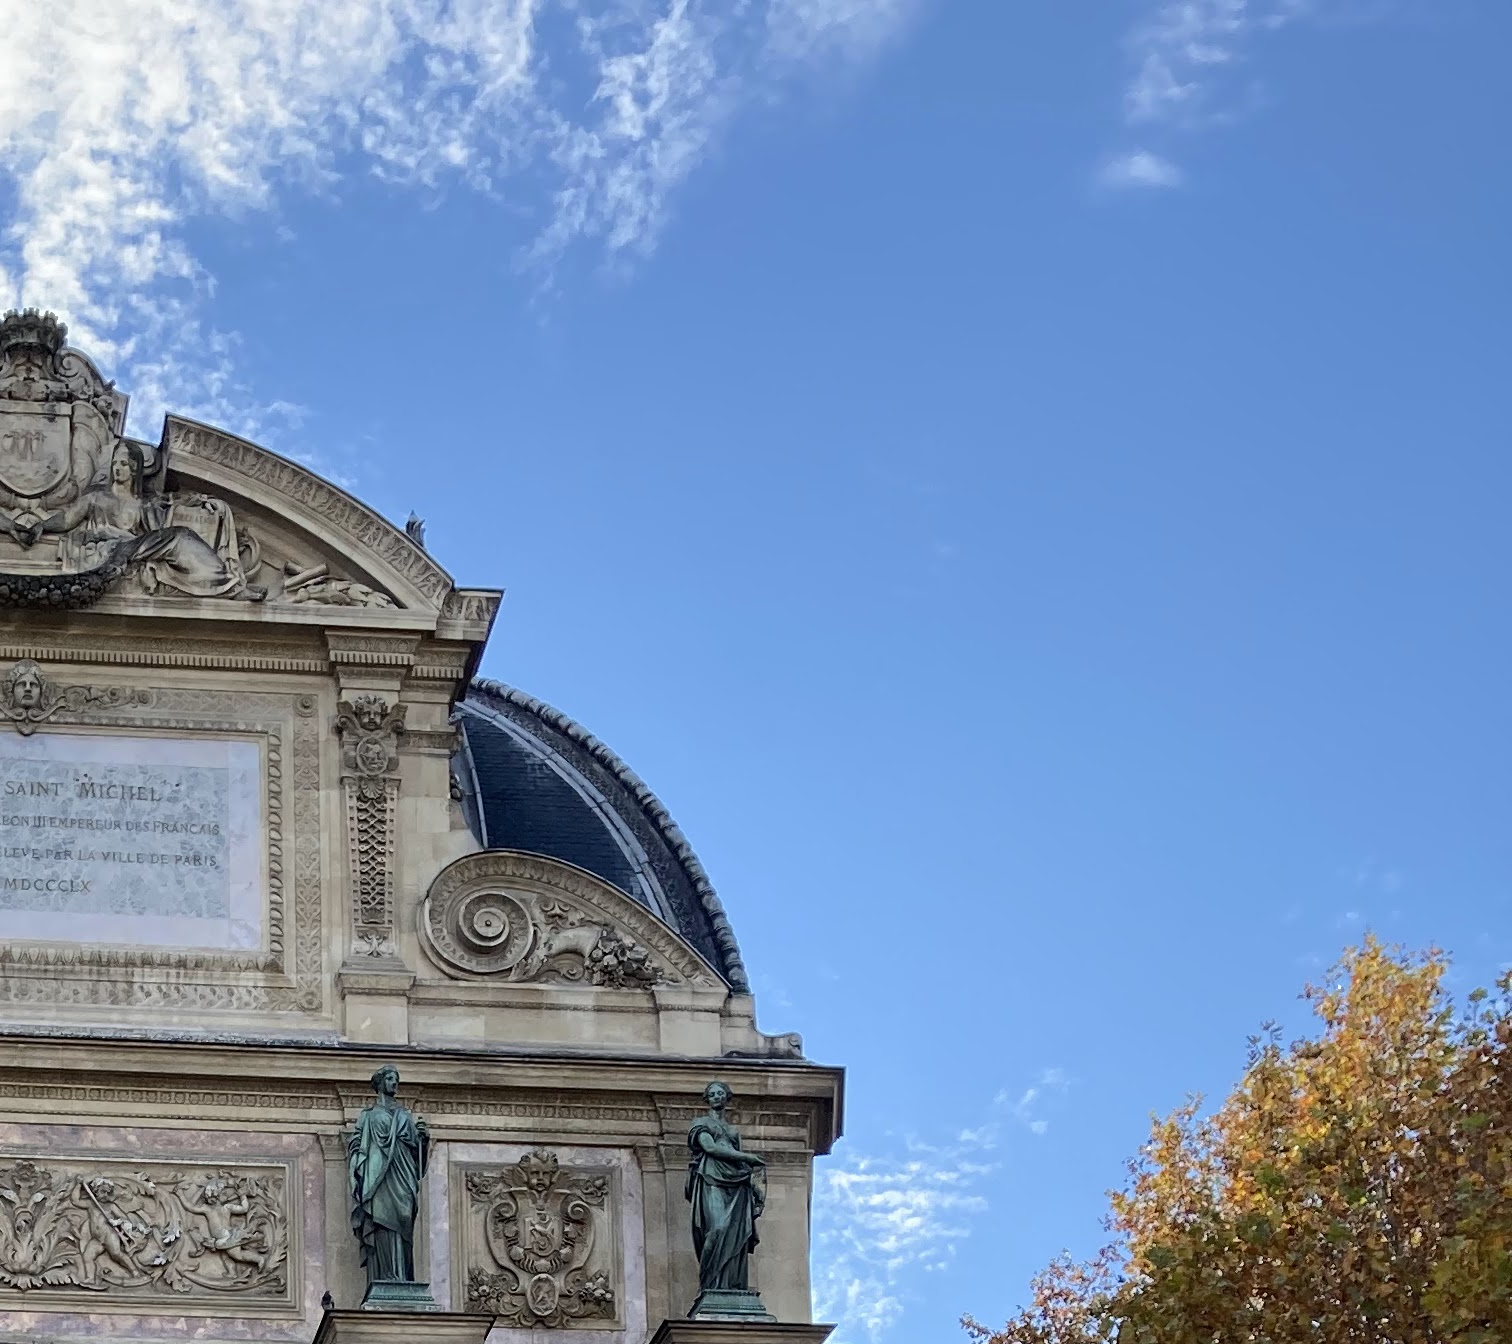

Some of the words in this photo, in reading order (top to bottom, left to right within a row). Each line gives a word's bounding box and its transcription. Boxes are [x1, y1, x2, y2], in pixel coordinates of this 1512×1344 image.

[4, 781, 64, 797] SAINT
[77, 782, 163, 802] MICHEL
[33, 815, 47, 828] III
[49, 816, 122, 831] EMPEREUR
[125, 820, 149, 832] DES
[45, 848, 74, 861] PAR
[78, 850, 96, 861] LA
[101, 851, 145, 864] VILLE
[150, 853, 169, 864] DE
[4, 878, 91, 893] MDCCCLX
